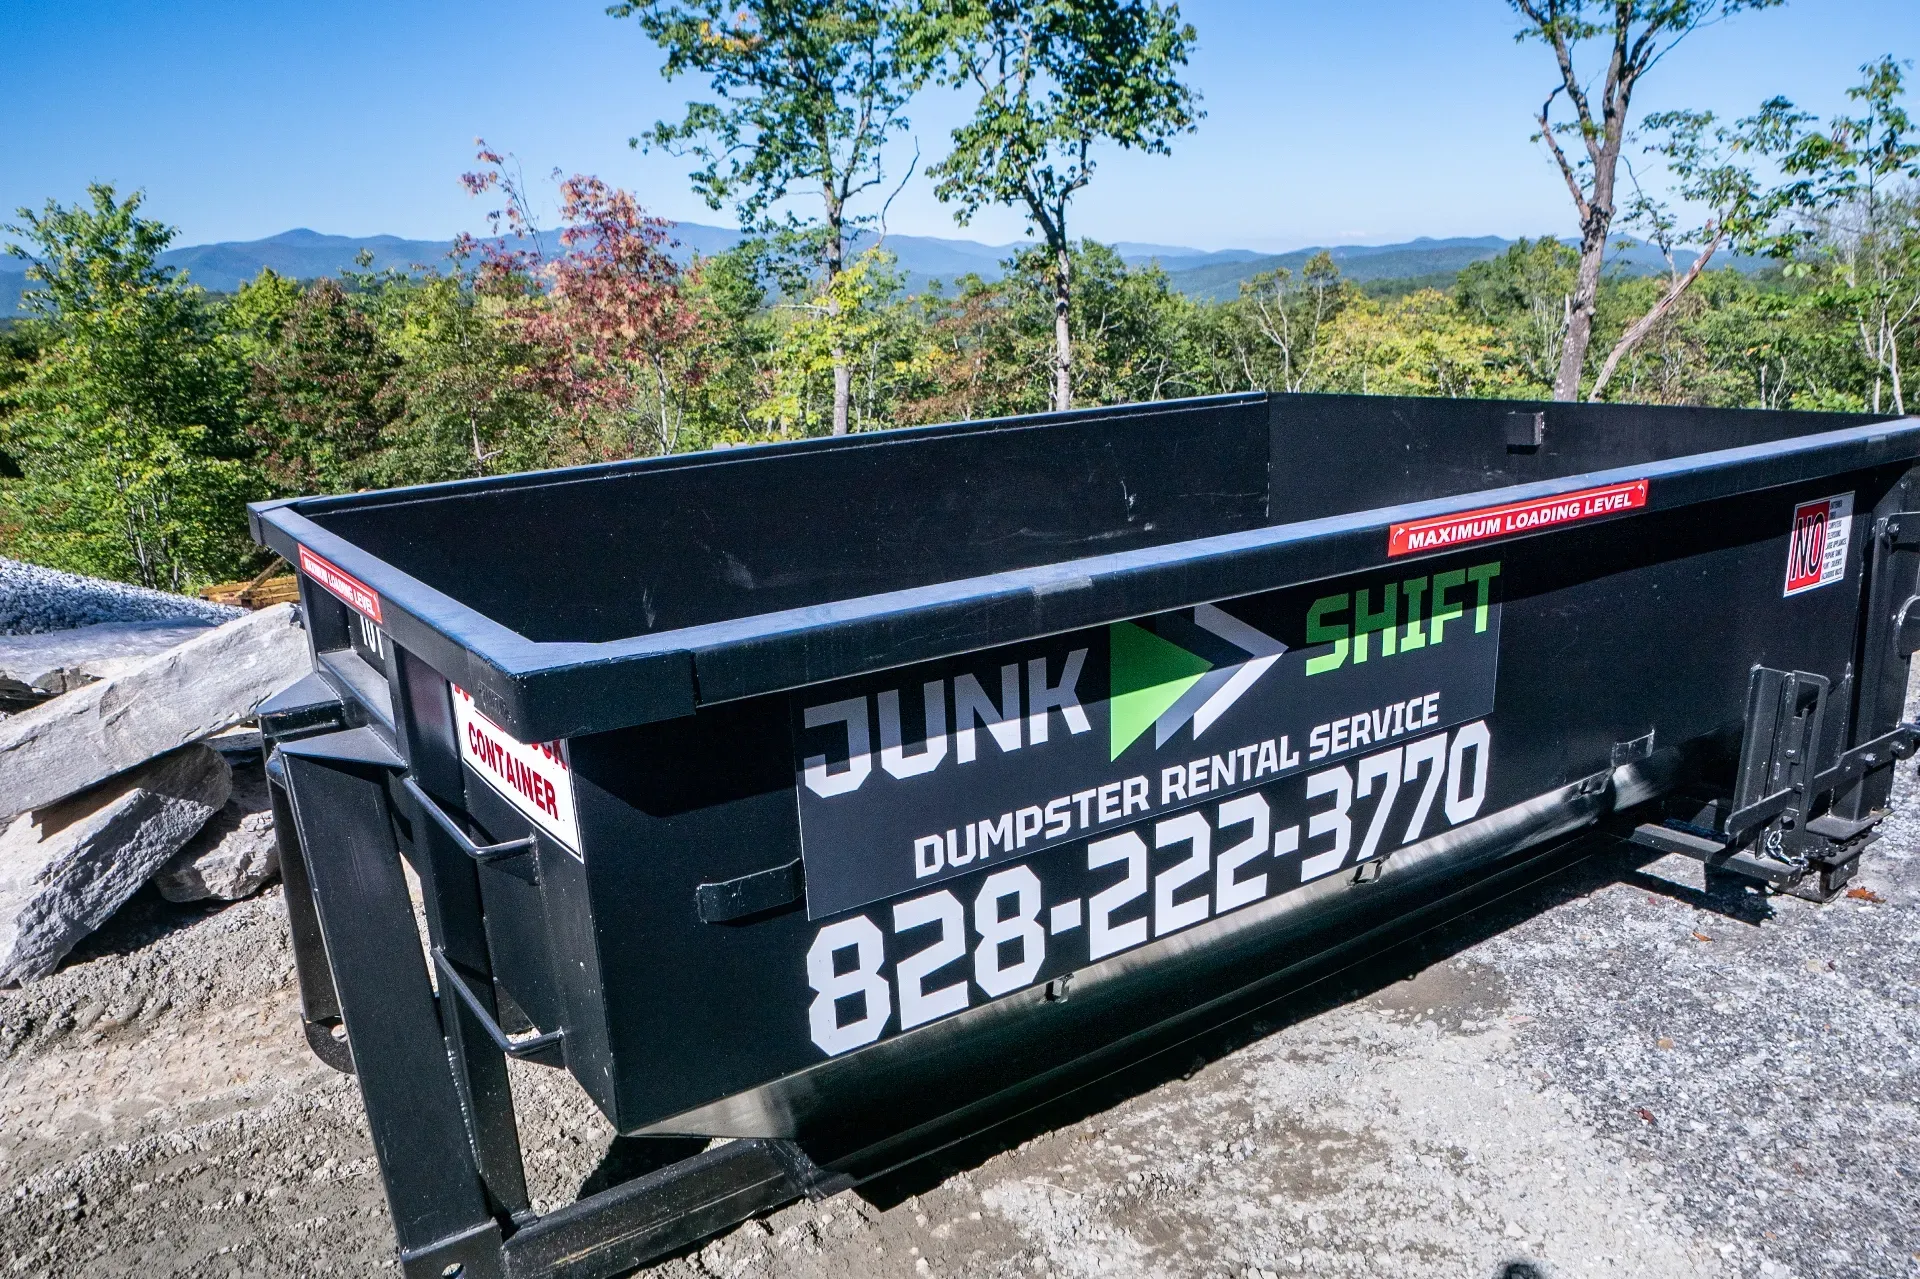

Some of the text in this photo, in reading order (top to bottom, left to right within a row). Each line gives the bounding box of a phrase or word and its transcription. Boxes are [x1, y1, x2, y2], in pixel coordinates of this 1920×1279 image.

[1408, 493, 1633, 550] MAXIMUM LOADING LEVEL
[1789, 511, 1826, 582] NO
[353, 588, 376, 617] LEVEL
[802, 561, 1502, 799] JUNK SHIFT
[467, 721, 559, 821] CONTAINER
[913, 692, 1441, 879] DUMPSTER RENTAL SERVICE
[807, 719, 1492, 1057] 828-222-3770
